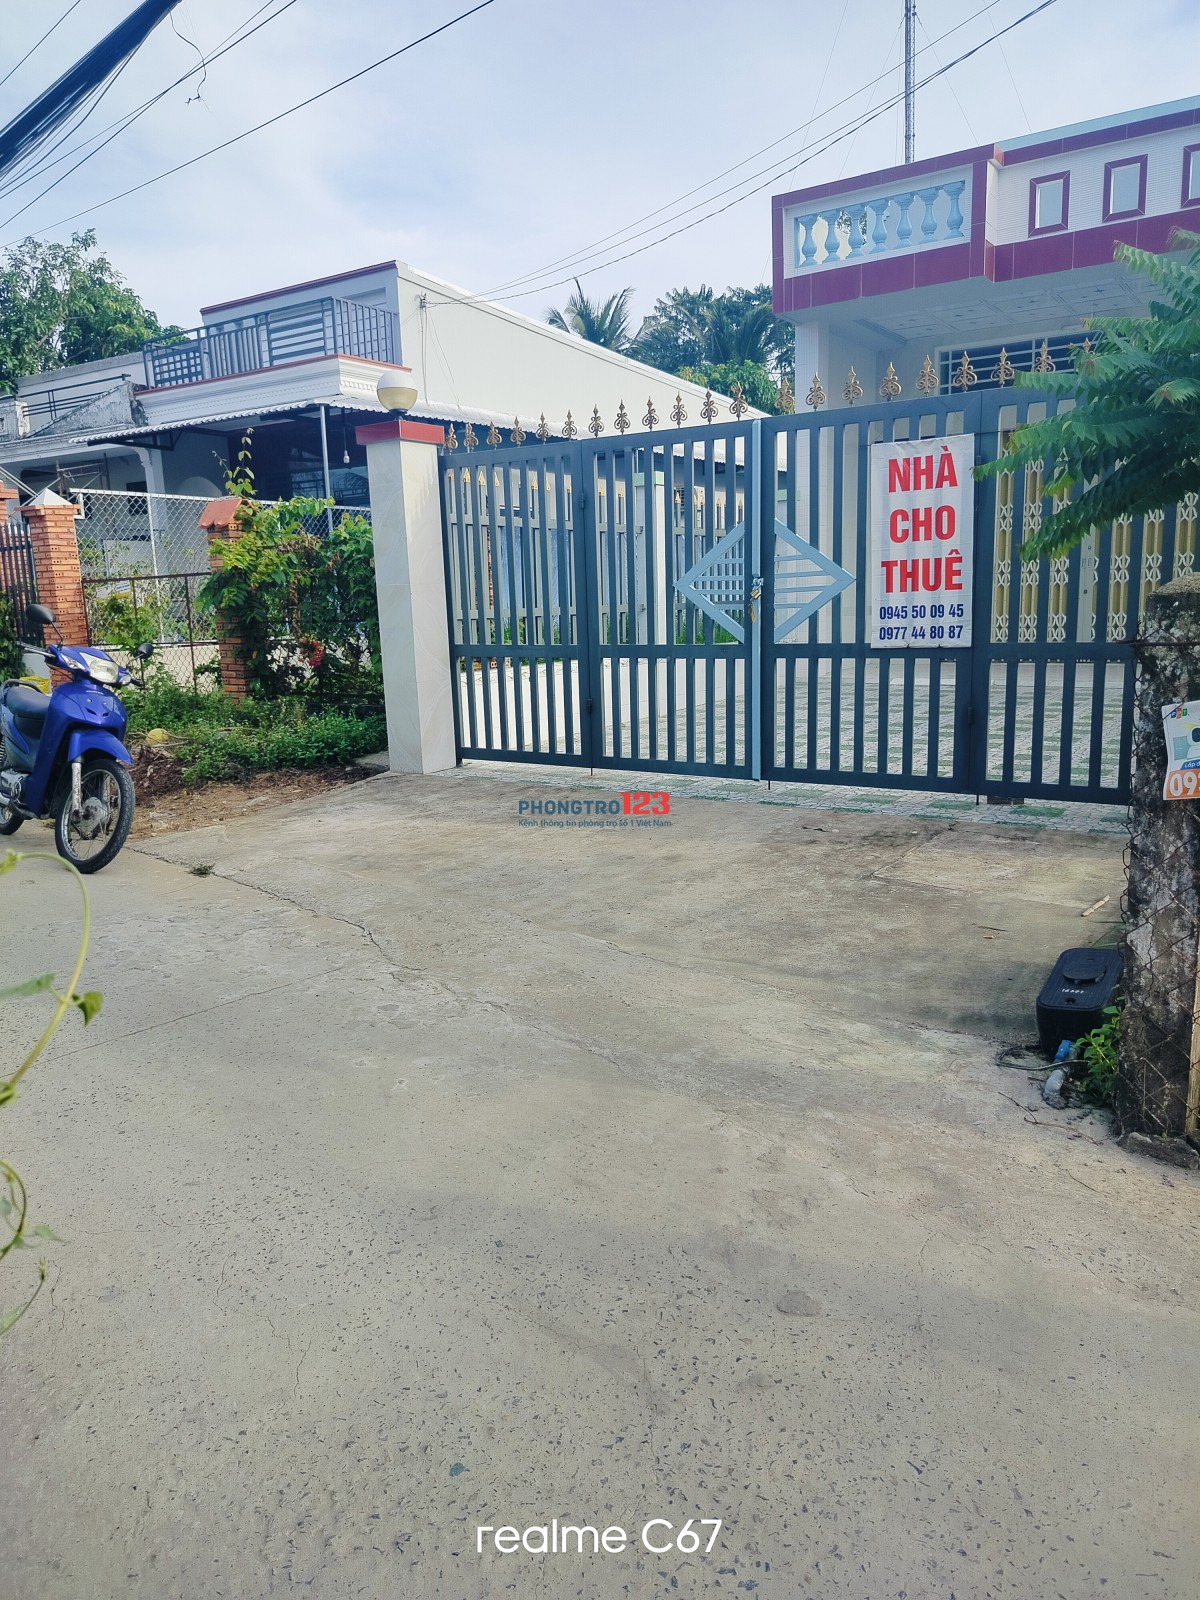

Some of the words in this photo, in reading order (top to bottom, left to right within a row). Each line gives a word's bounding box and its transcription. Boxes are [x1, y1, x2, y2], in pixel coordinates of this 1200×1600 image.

[888, 445, 958, 493] NHÀ
[889, 505, 956, 544] CHO
[881, 549, 963, 593] THUÊ
[879, 605, 908, 620] 0945
[911, 605, 926, 619] 50
[930, 604, 945, 618] 09
[948, 603, 964, 618] 45
[879, 626, 908, 640] 0977
[911, 625, 926, 640] 44
[929, 625, 944, 639] 80
[948, 625, 964, 639] 87
[1170, 771, 1200, 797] 09
